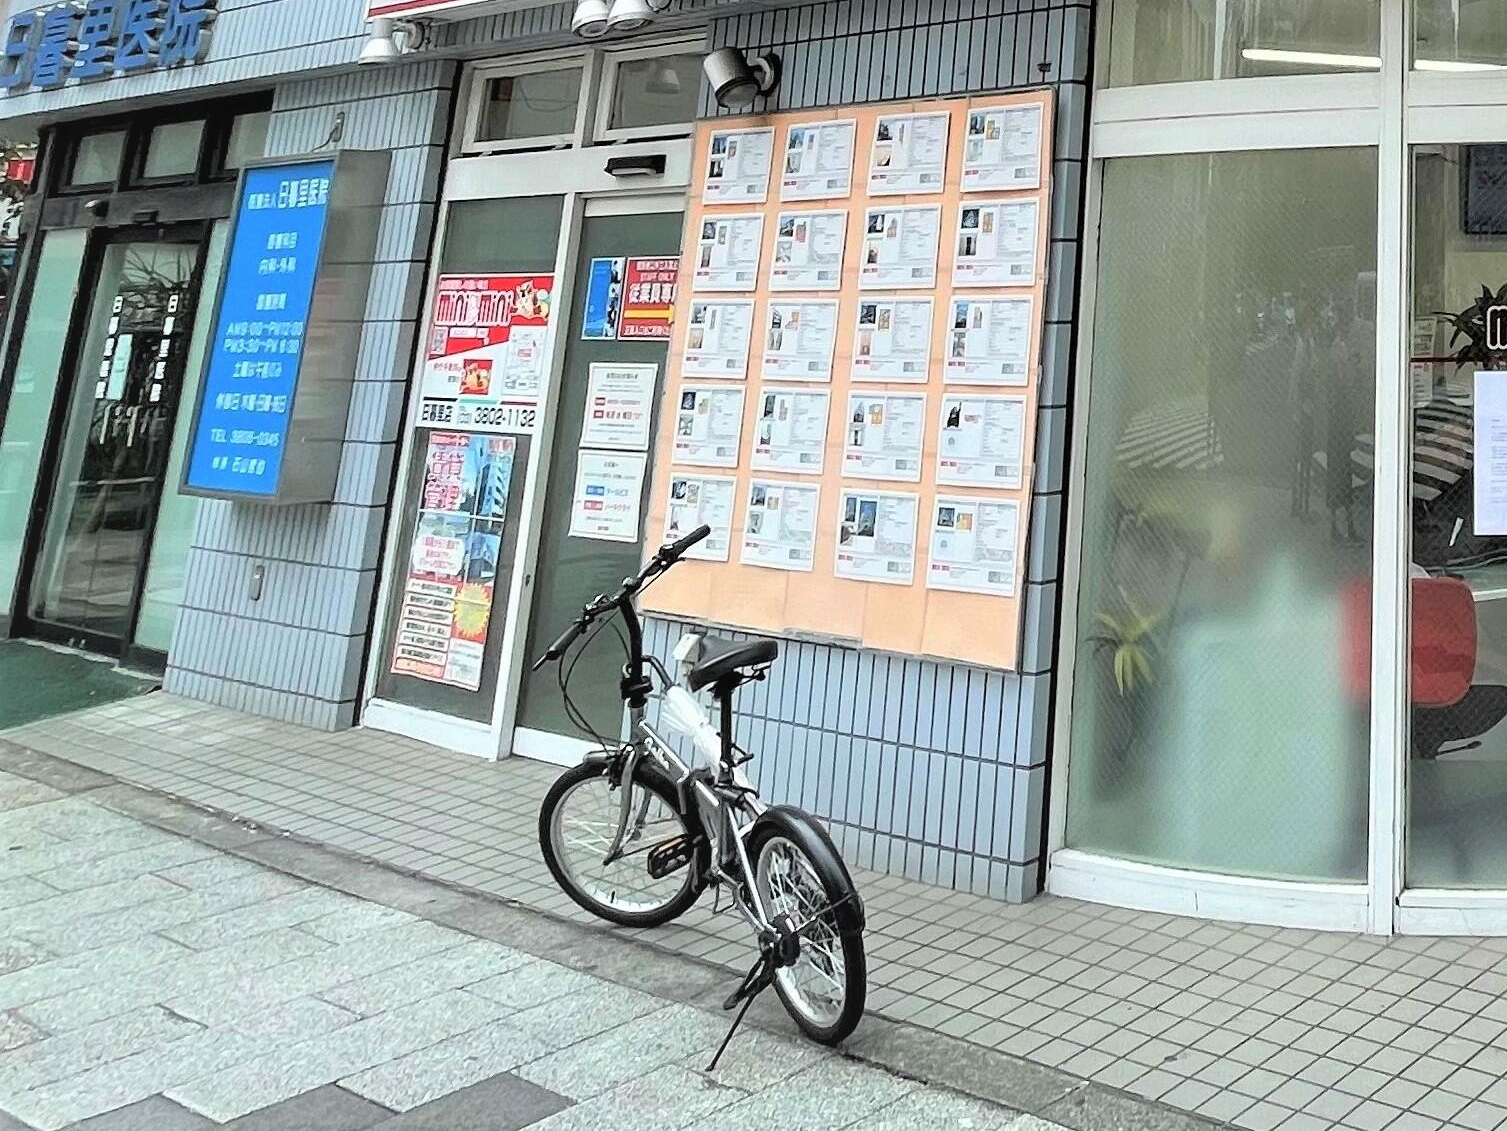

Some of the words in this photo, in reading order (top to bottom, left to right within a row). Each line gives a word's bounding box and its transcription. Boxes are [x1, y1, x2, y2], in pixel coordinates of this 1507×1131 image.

[437, 293, 470, 323] mini
[478, 293, 512, 323] mini
[211, 428, 227, 443] TEL
